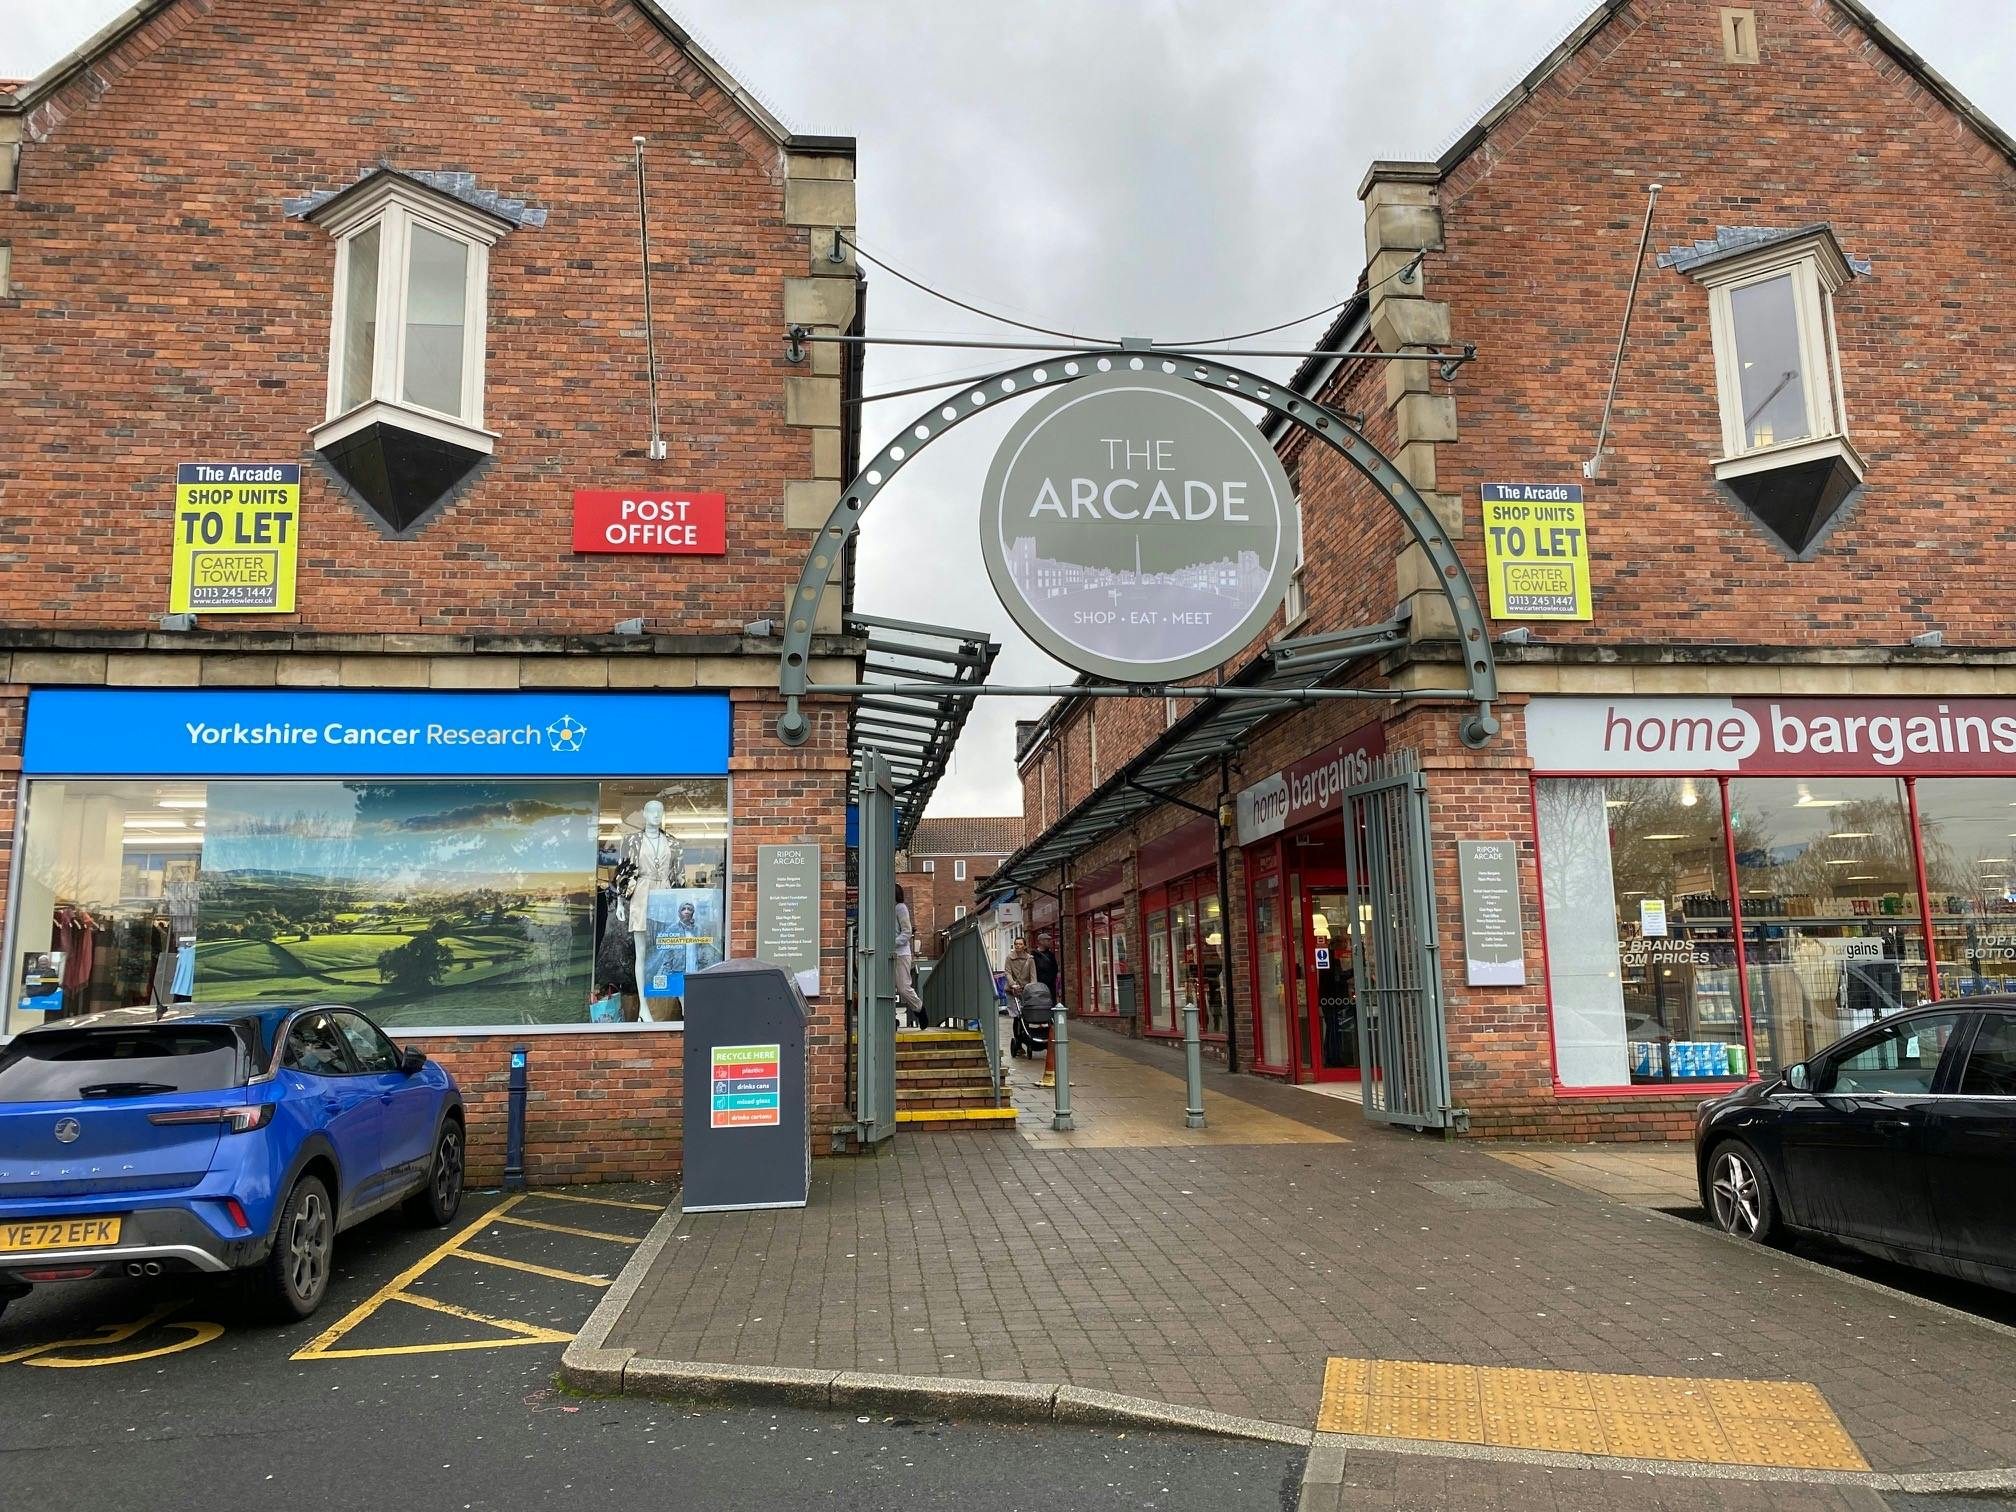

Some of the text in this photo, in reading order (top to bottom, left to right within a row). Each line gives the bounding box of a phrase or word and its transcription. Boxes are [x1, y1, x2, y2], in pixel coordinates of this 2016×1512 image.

[1100, 439, 1176, 471] THE
[196, 466, 283, 482] The Arcade
[188, 489, 288, 505] SHOP UNITS
[1028, 477, 1250, 521] ARCADE
[1496, 485, 1568, 501] The Arcade
[621, 500, 691, 521] POST
[1493, 506, 1575, 522] SHOP UNITS
[181, 511, 293, 545] TO LET
[605, 523, 698, 546] OFFICE
[1489, 526, 1582, 557] TO LET
[201, 557, 263, 570] CARTER
[201, 570, 268, 583] TOWLER
[1511, 568, 1564, 580] CARTER
[193, 587, 273, 598] 0113 245 1447
[1513, 580, 1568, 592] TOWLER
[193, 597, 273, 605] www.cartertowler.co.uk
[1508, 595, 1574, 606] 0113 245 1447
[1073, 611, 1213, 625] SHOP EAT MEET
[185, 722, 542, 745] Yorkshire Cancer Research
[1603, 704, 2016, 766] home bargains
[1253, 747, 1368, 826] home bargains
[776, 850, 802, 858] RIPON
[773, 857, 805, 865] ARCADE
[1630, 940, 1695, 951] BRANDS
[1976, 935, 2006, 946] TOP
[1652, 952, 1710, 964] PRICES
[1964, 947, 2016, 959] BOTTO
[716, 1051, 775, 1060] RECYCLE HERE
[741, 1067, 764, 1075] plastics
[7, 1221, 110, 1246] YE72 EFK
